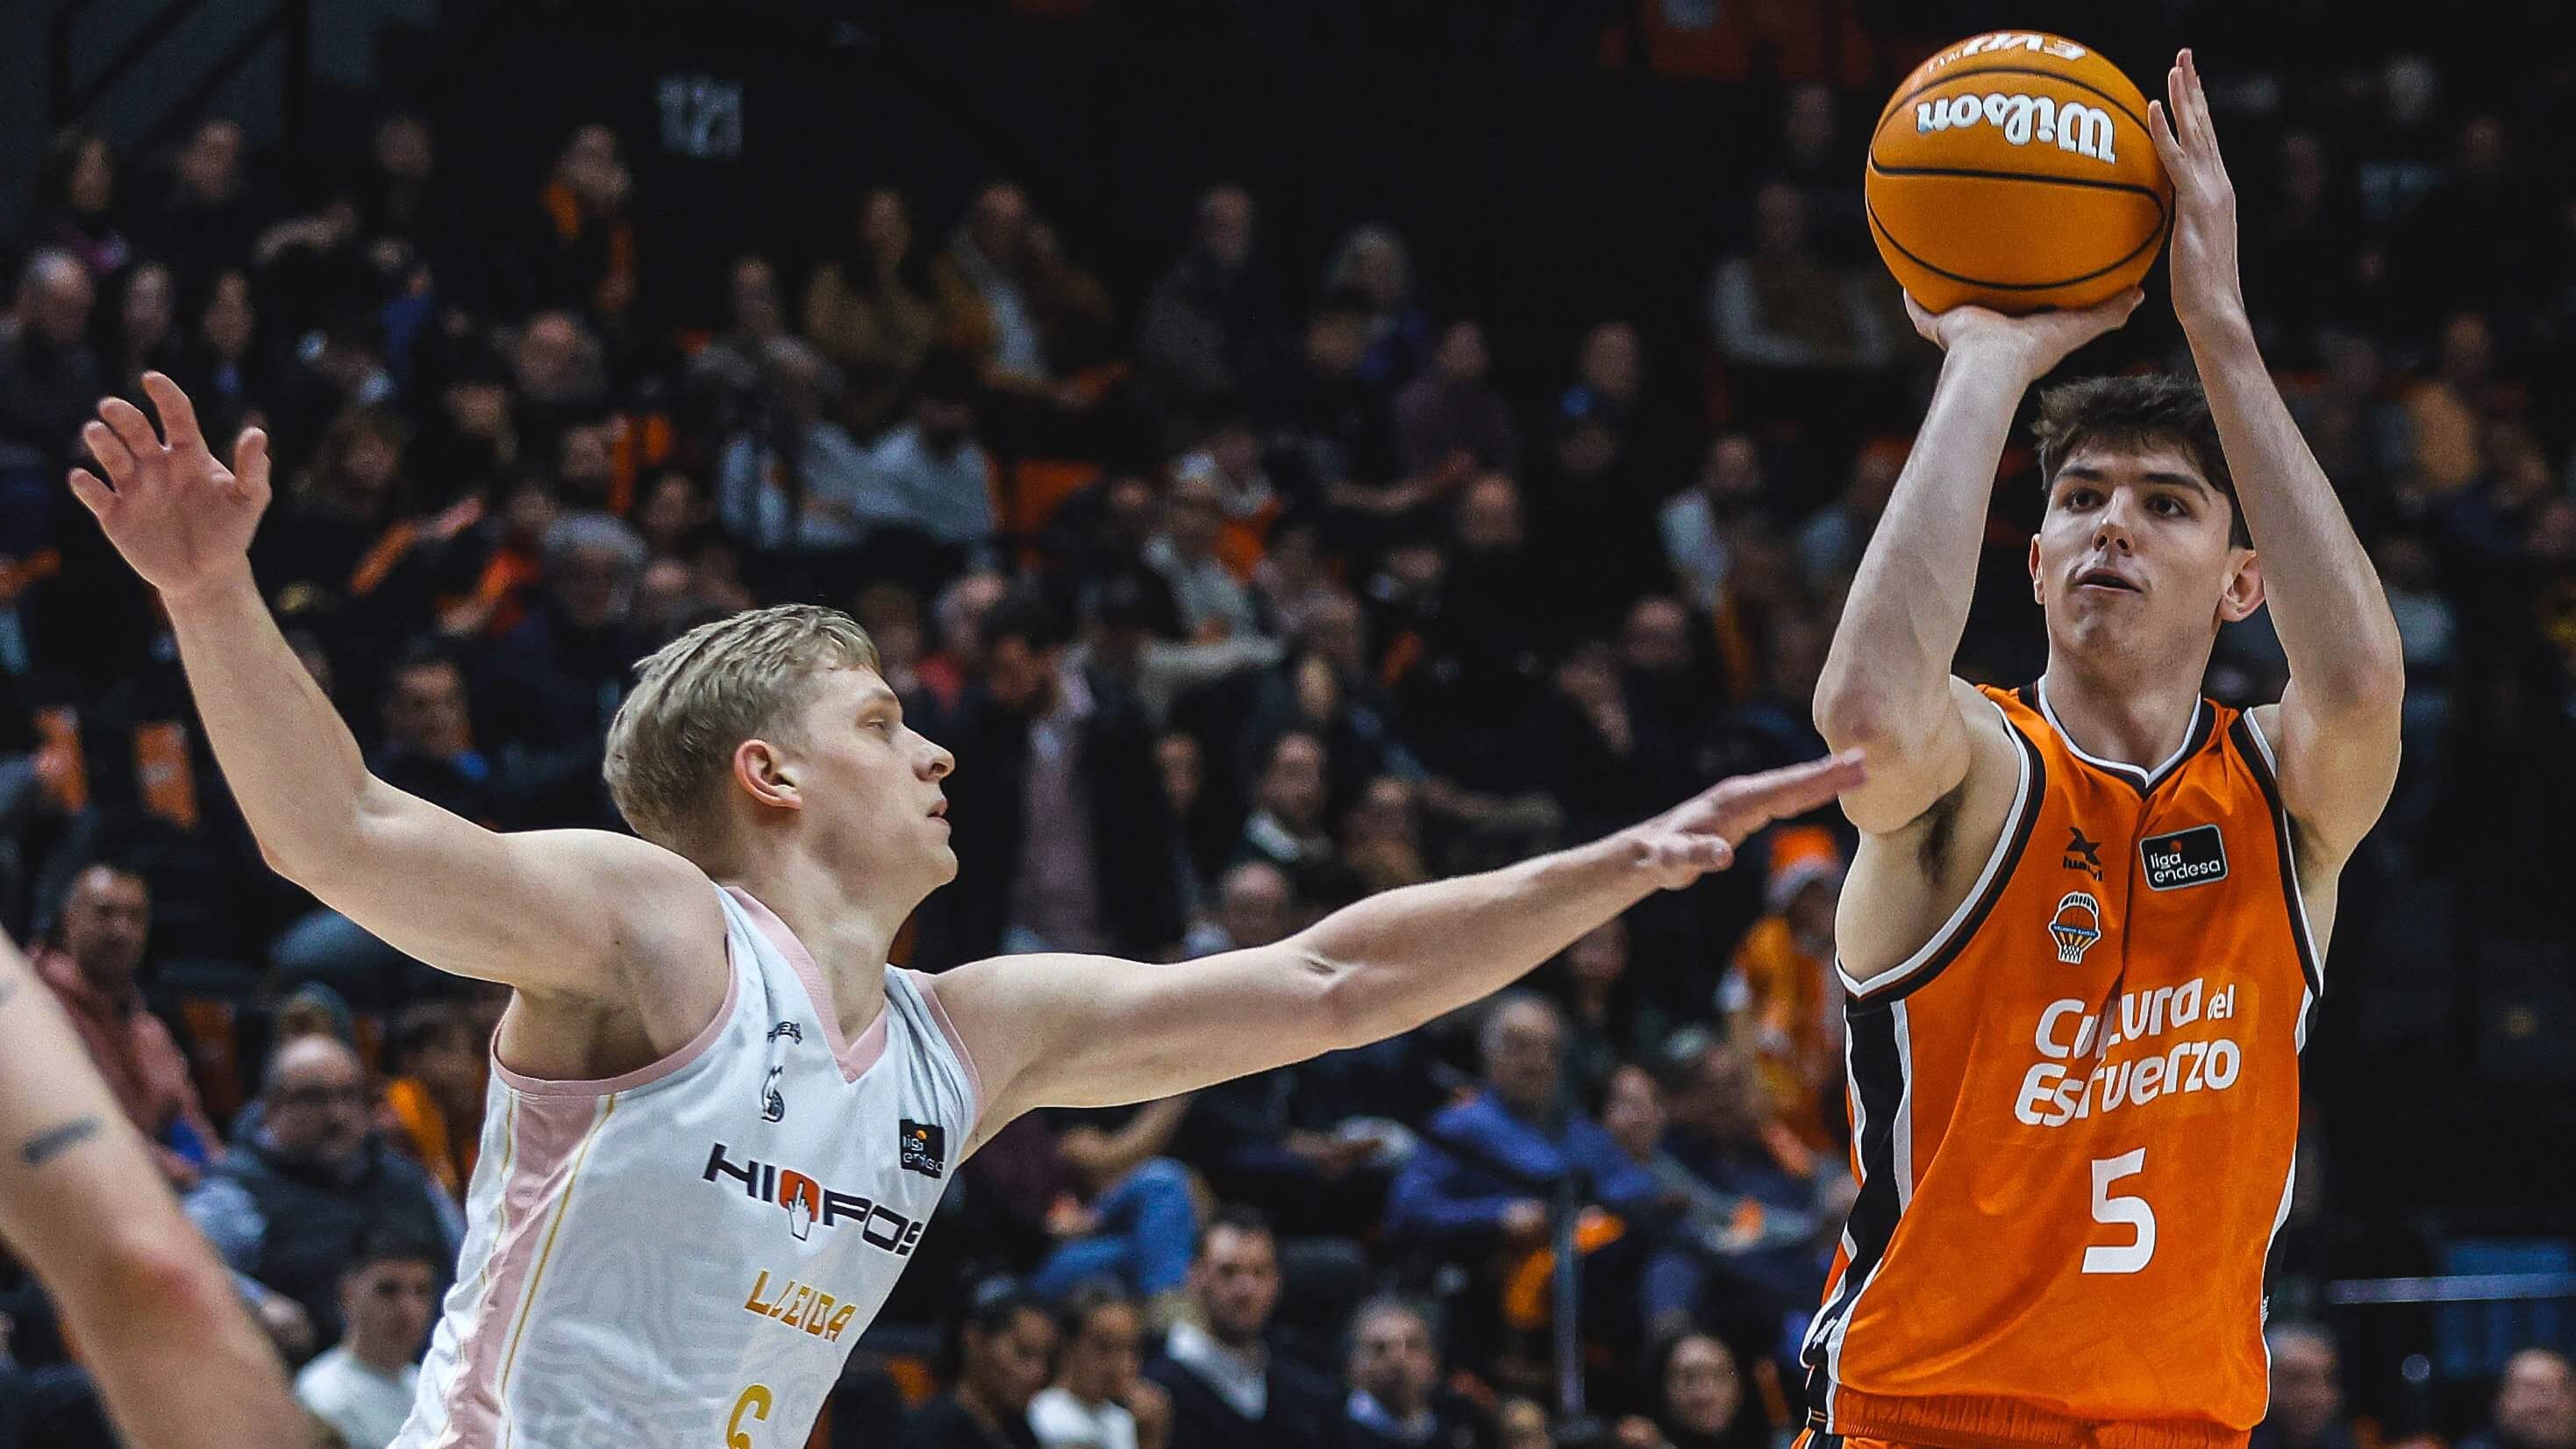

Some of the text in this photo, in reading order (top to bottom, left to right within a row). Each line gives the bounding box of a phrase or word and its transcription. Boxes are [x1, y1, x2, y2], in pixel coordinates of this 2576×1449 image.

[1916, 92, 2116, 165] Wilson
[2150, 852, 2181, 870] liga
[2154, 859, 2221, 883] endesa
[2081, 1146, 2157, 1274] 5
[744, 1269, 858, 1343] LLEIDA
[726, 1383, 774, 1449] 6
